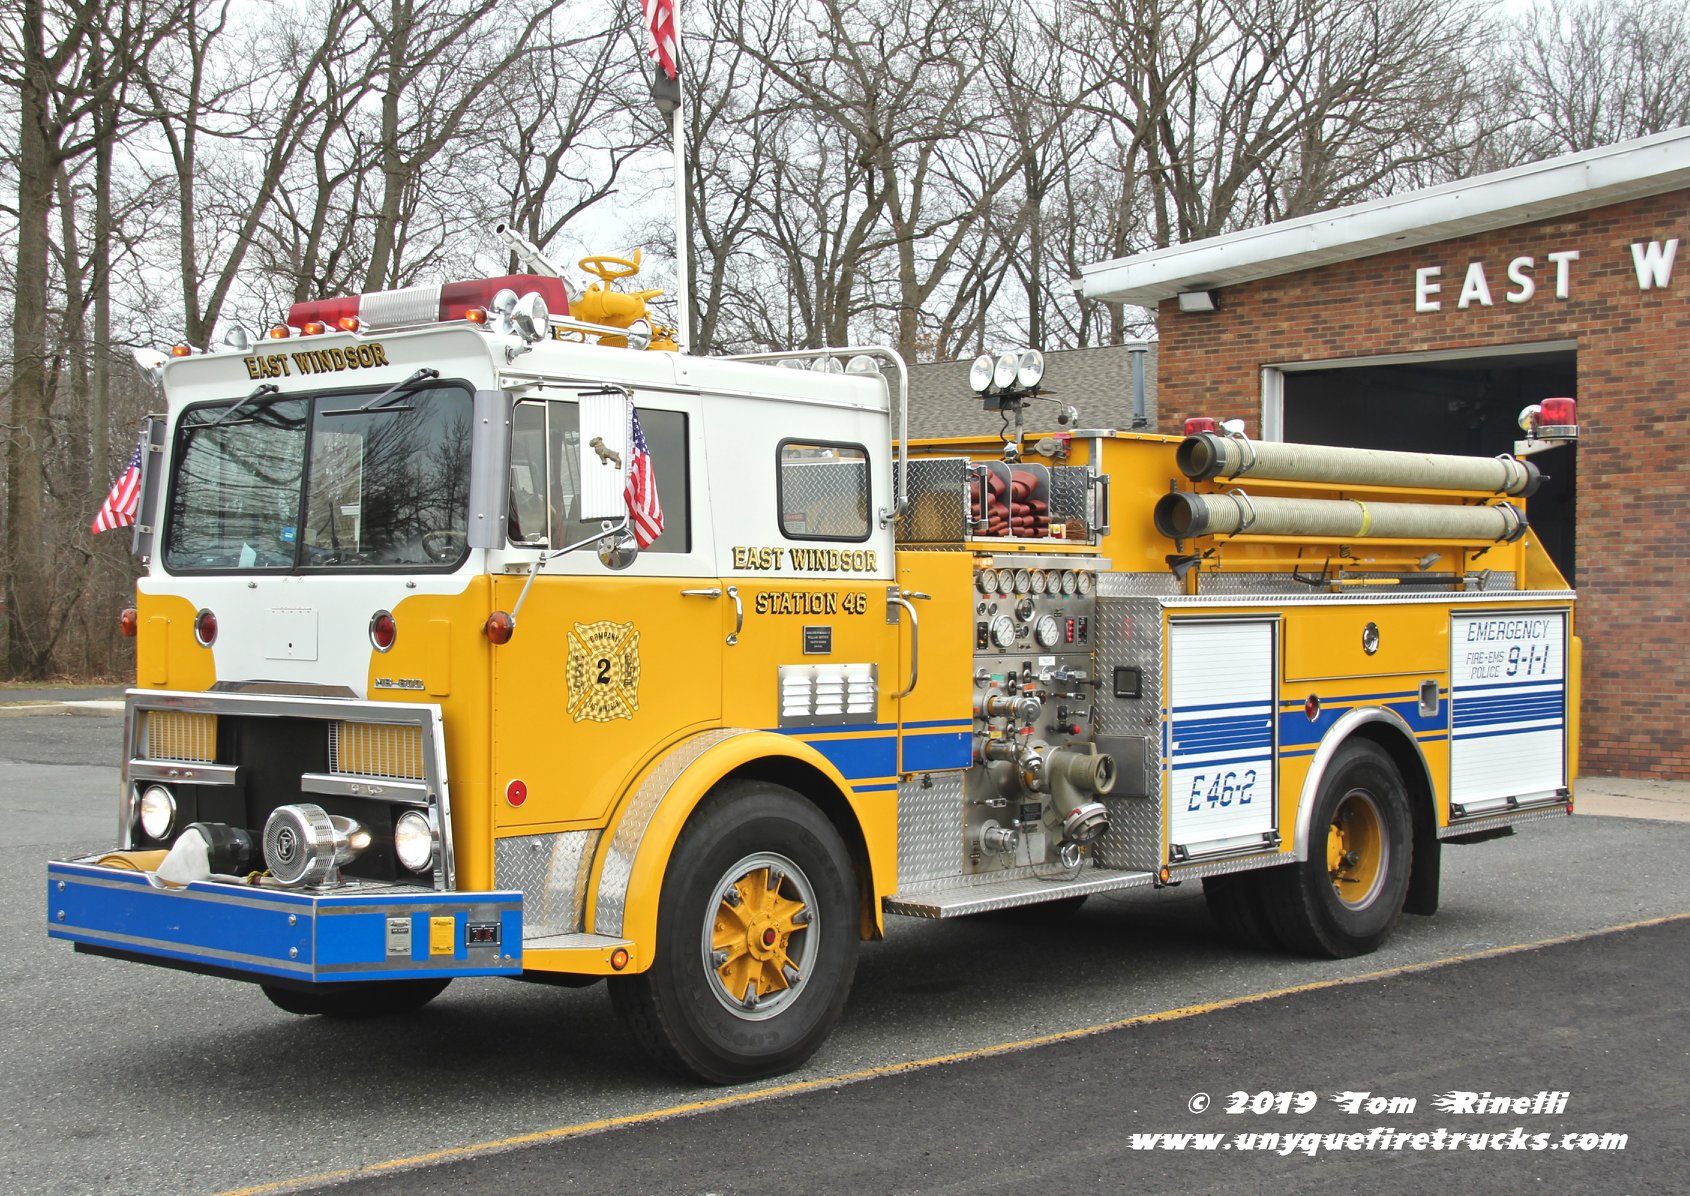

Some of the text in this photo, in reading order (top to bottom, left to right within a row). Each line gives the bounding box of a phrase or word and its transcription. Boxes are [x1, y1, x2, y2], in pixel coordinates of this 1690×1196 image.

[1415, 239, 1679, 312] EAST W
[244, 343, 389, 380] EAST WINDSOR
[731, 545, 878, 573] EAST WINDSOR
[755, 590, 868, 615] STATION 46
[589, 631, 619, 644] COMPANY
[1467, 619, 1550, 642] EMERGENCY
[597, 658, 611, 685] 2
[1466, 644, 1549, 677] FIRE-EMS 9-1-1
[1471, 665, 1500, 679] POLICE
